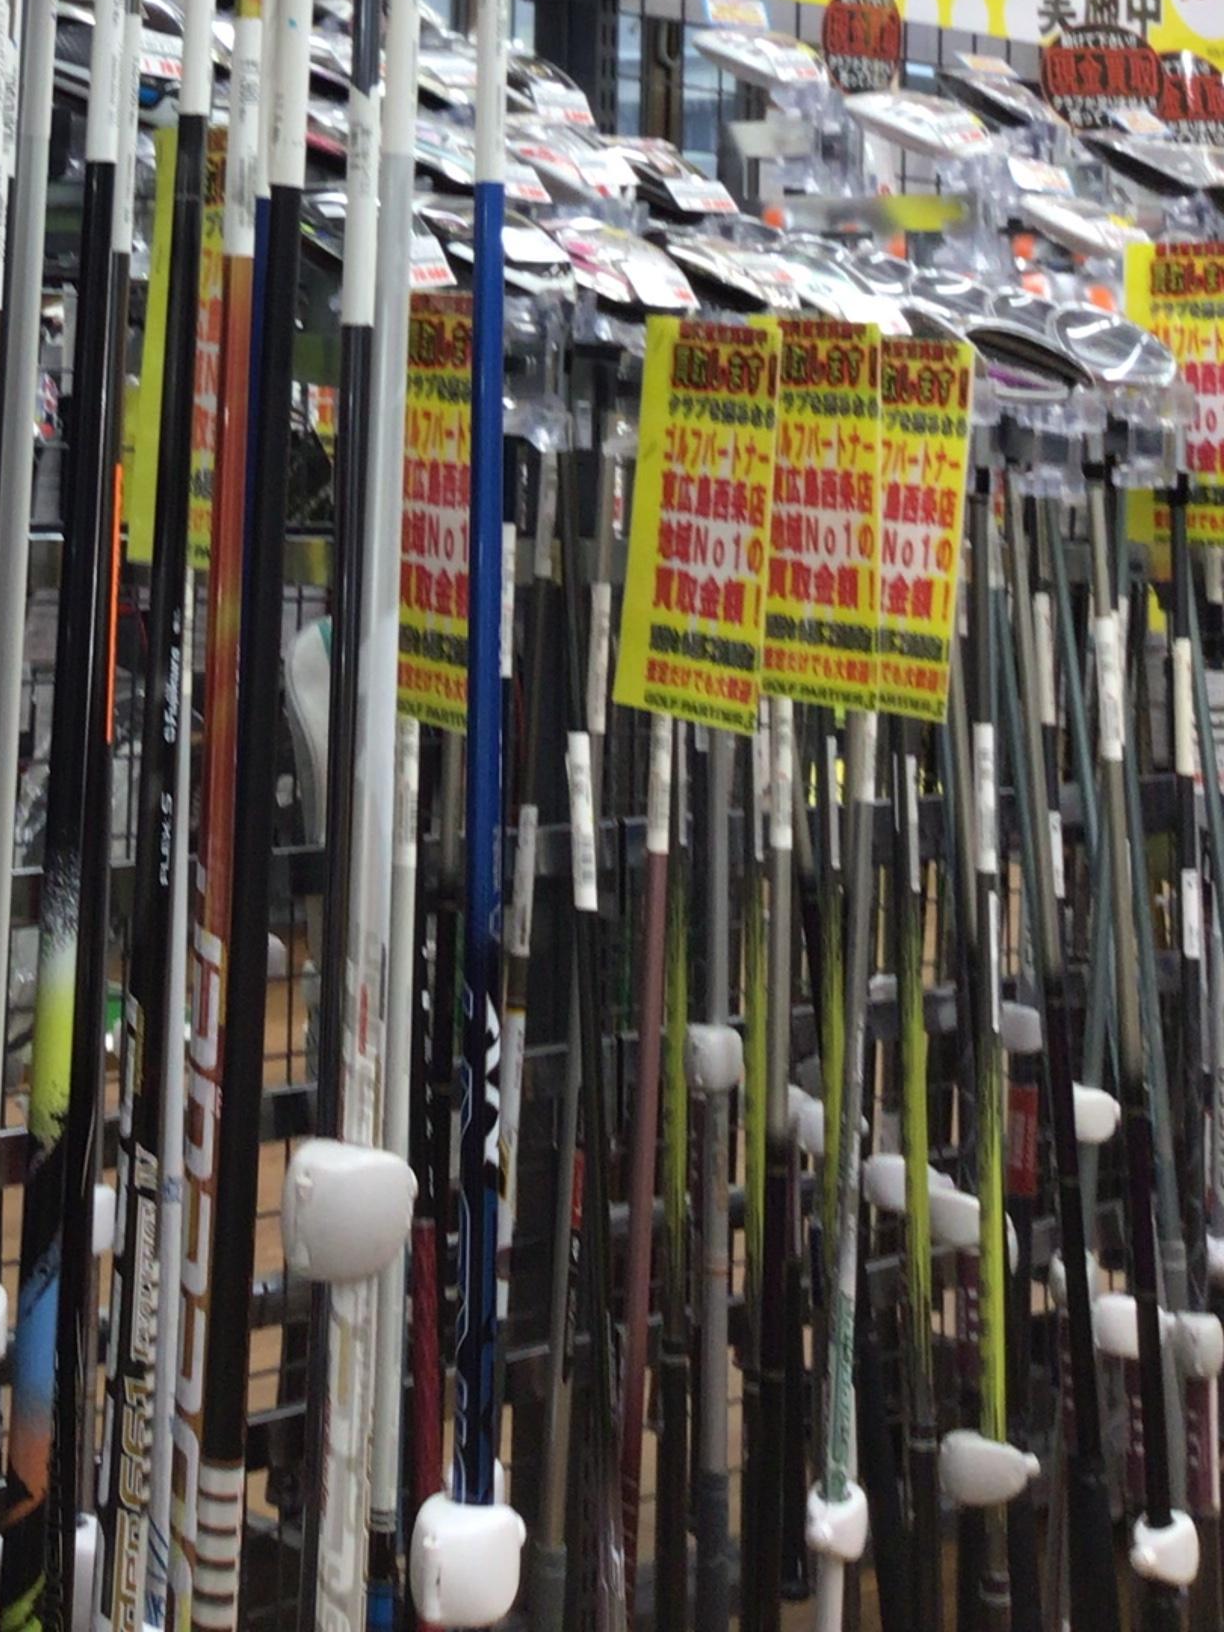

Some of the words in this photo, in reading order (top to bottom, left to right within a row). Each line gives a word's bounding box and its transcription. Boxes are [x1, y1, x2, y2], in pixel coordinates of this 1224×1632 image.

[779, 422, 875, 465] ルフパートナー
[164, 647, 182, 726] Fujikura
